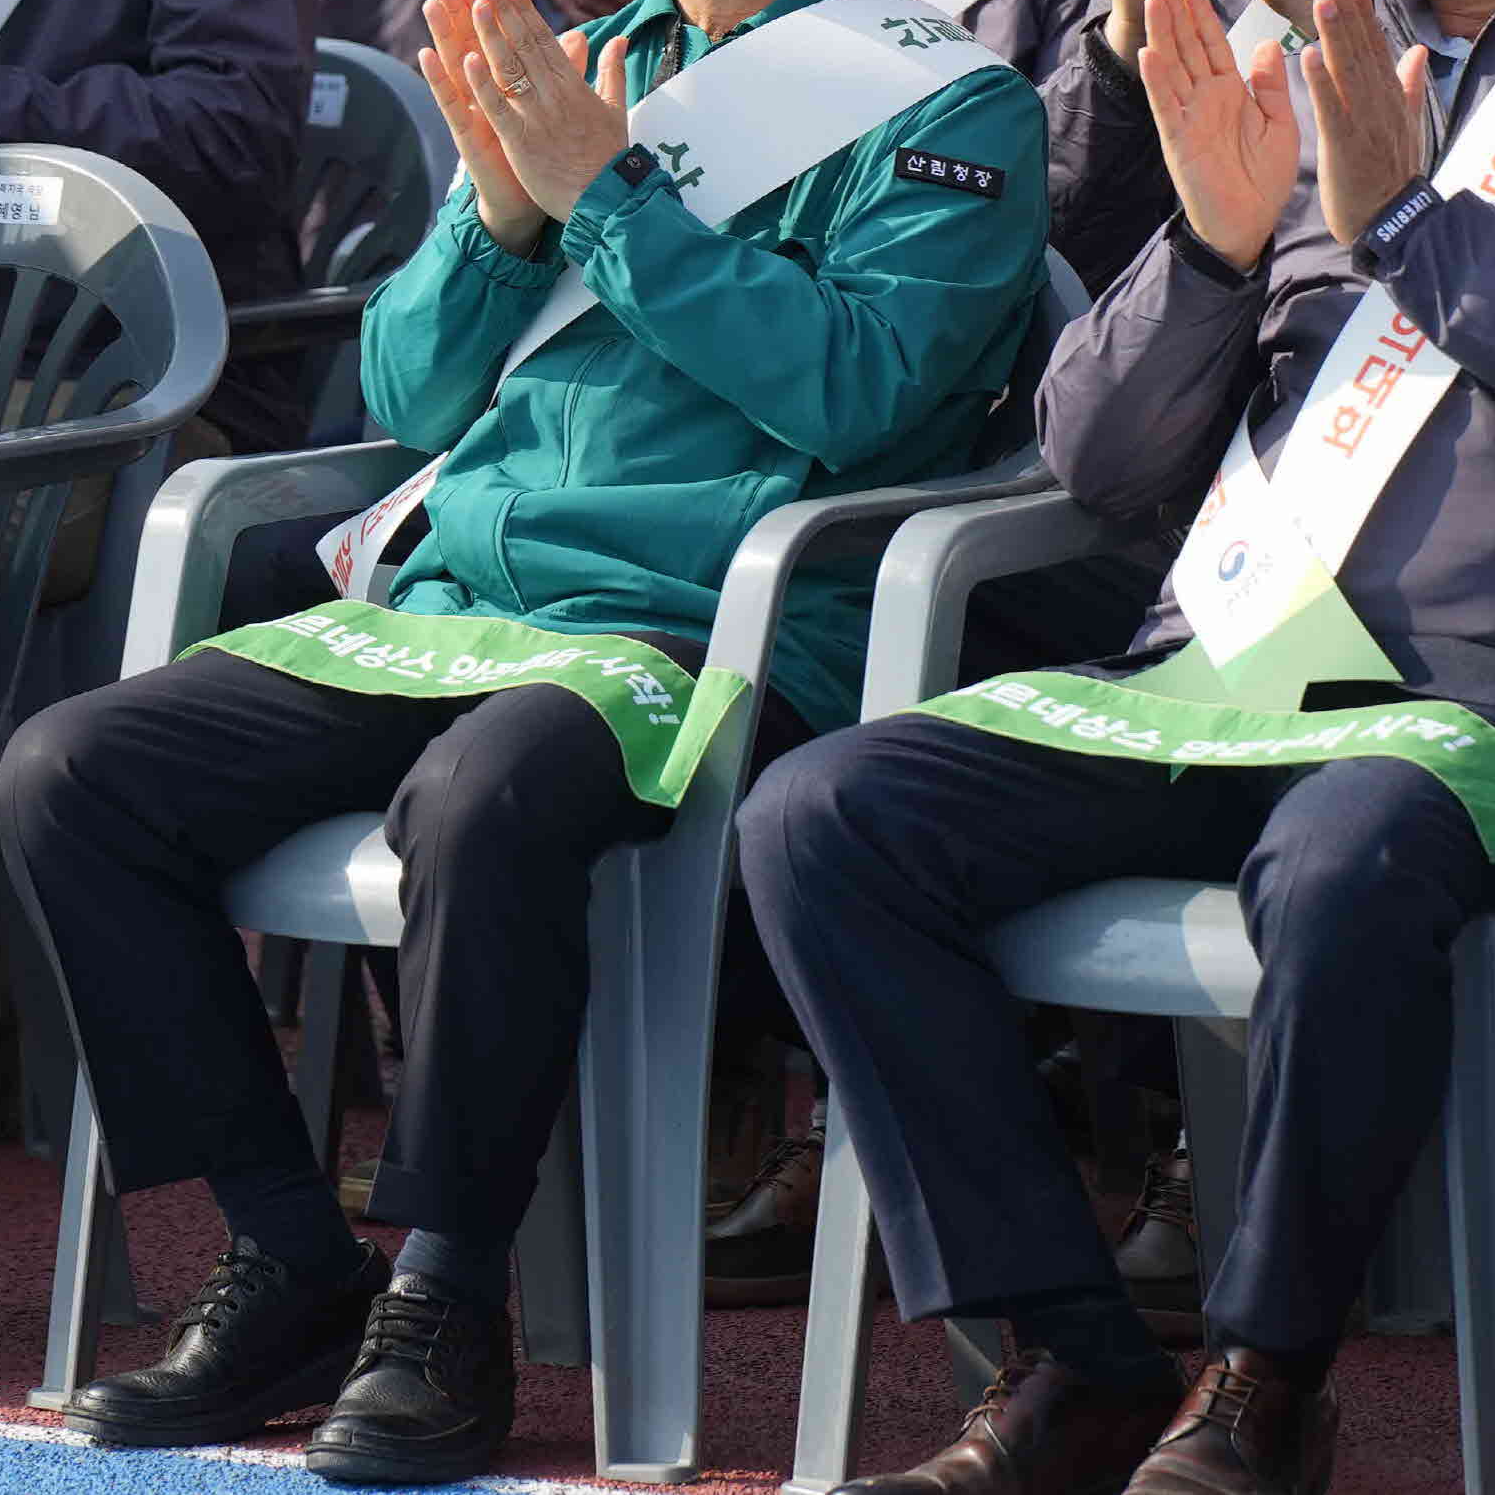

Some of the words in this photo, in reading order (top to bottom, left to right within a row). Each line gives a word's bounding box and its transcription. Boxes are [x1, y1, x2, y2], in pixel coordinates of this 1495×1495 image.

[907, 155, 993, 188] 산림청장
[28, 203, 41, 221] 님
[1322, 310, 1427, 459] 의대회
[586, 656, 682, 727] 시작!
